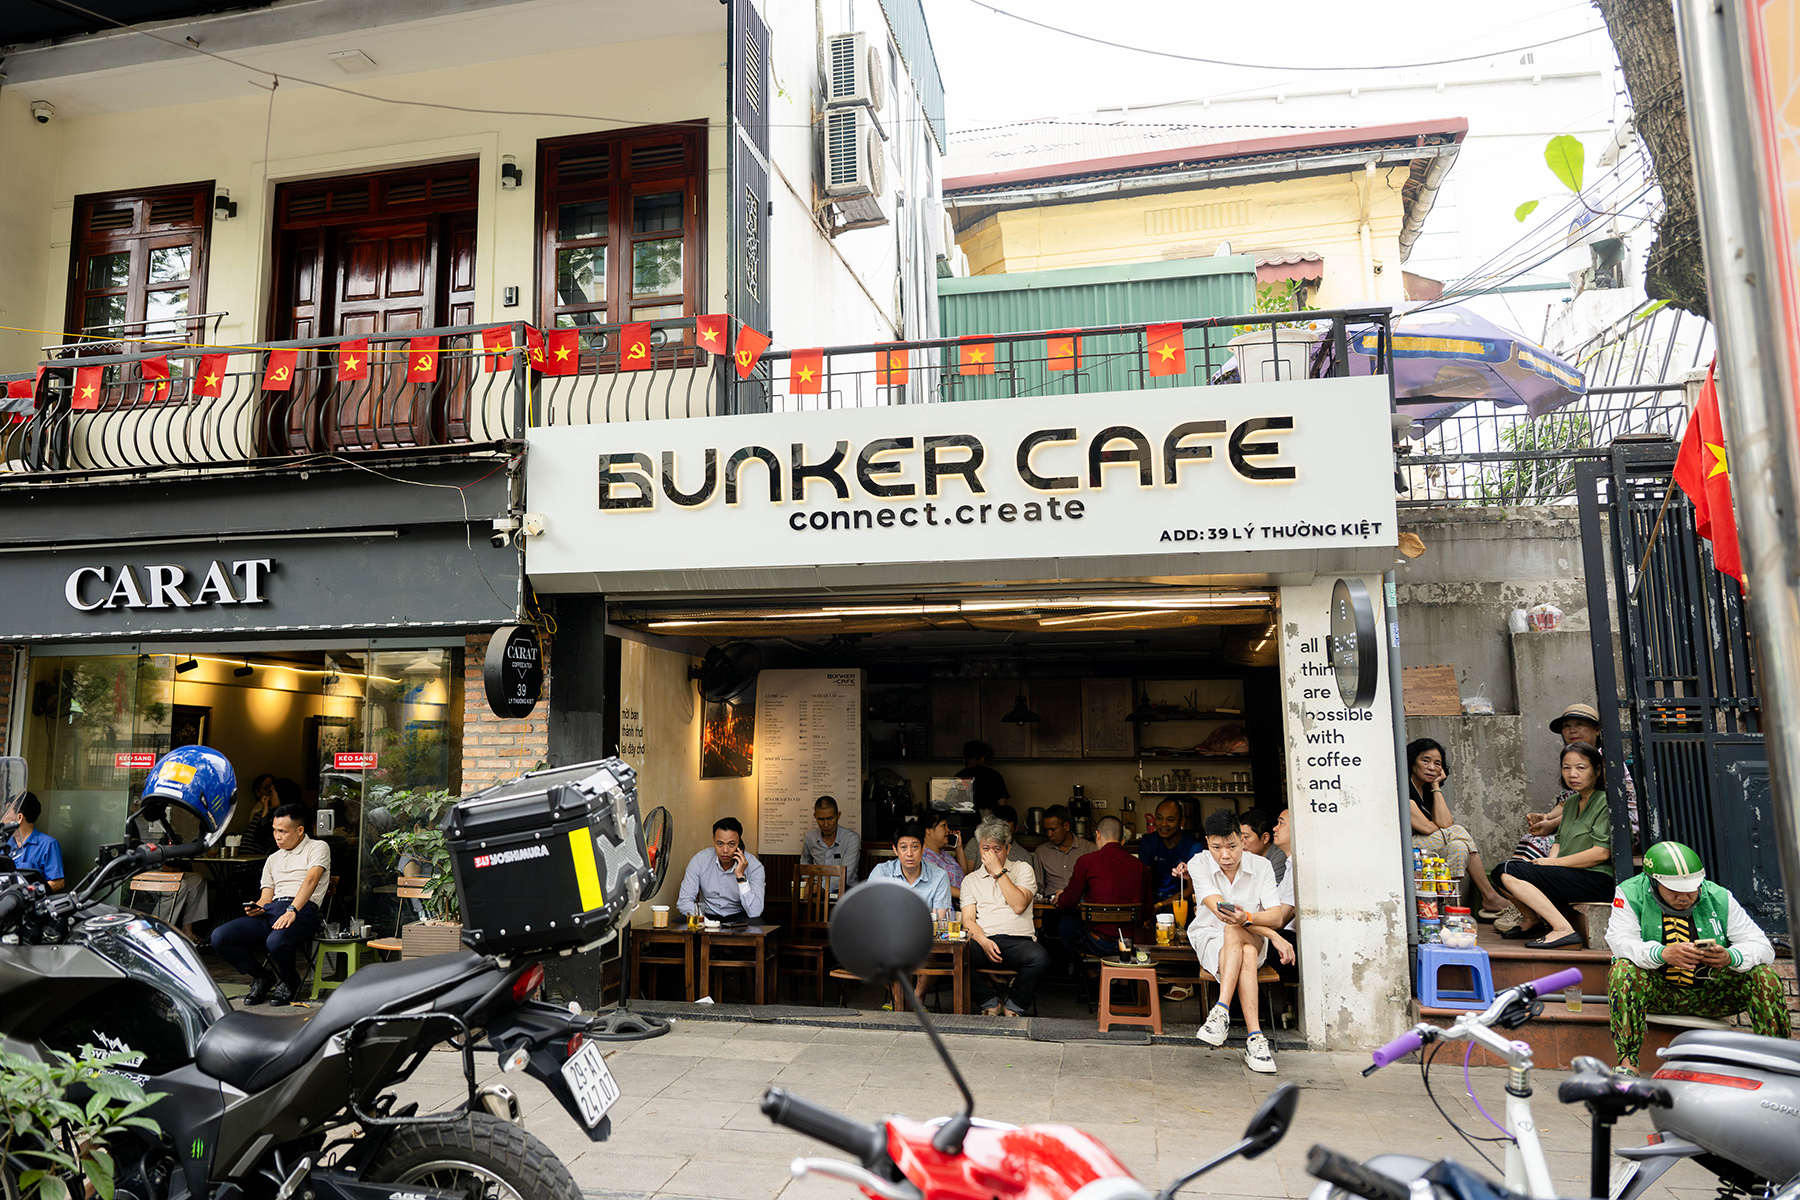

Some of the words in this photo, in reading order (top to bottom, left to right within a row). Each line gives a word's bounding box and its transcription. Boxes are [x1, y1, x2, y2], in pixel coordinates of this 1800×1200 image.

[598, 433, 987, 511] BUNKER
[1016, 415, 1298, 491] CAFE
[788, 496, 1086, 532] connect.create
[1207, 527, 1229, 540] 39
[1232, 522, 1256, 540] LÝ
[1260, 519, 1337, 539] THƯỜNG
[1340, 519, 1383, 540] KIỆT
[64, 558, 274, 611] CARAT
[507, 645, 537, 660] CARAT
[1300, 638, 1318, 652] all
[1301, 661, 1334, 677] thin
[516, 683, 527, 697] 39
[1303, 688, 1331, 699] are
[1306, 728, 1345, 744] with
[1307, 751, 1362, 767] coffee
[1309, 775, 1341, 790] and
[1310, 798, 1338, 813] tea
[489, 844, 550, 866] YOSHIMURA
[569, 1048, 601, 1091] 29-A1
[581, 1071, 616, 1122] 247.07
